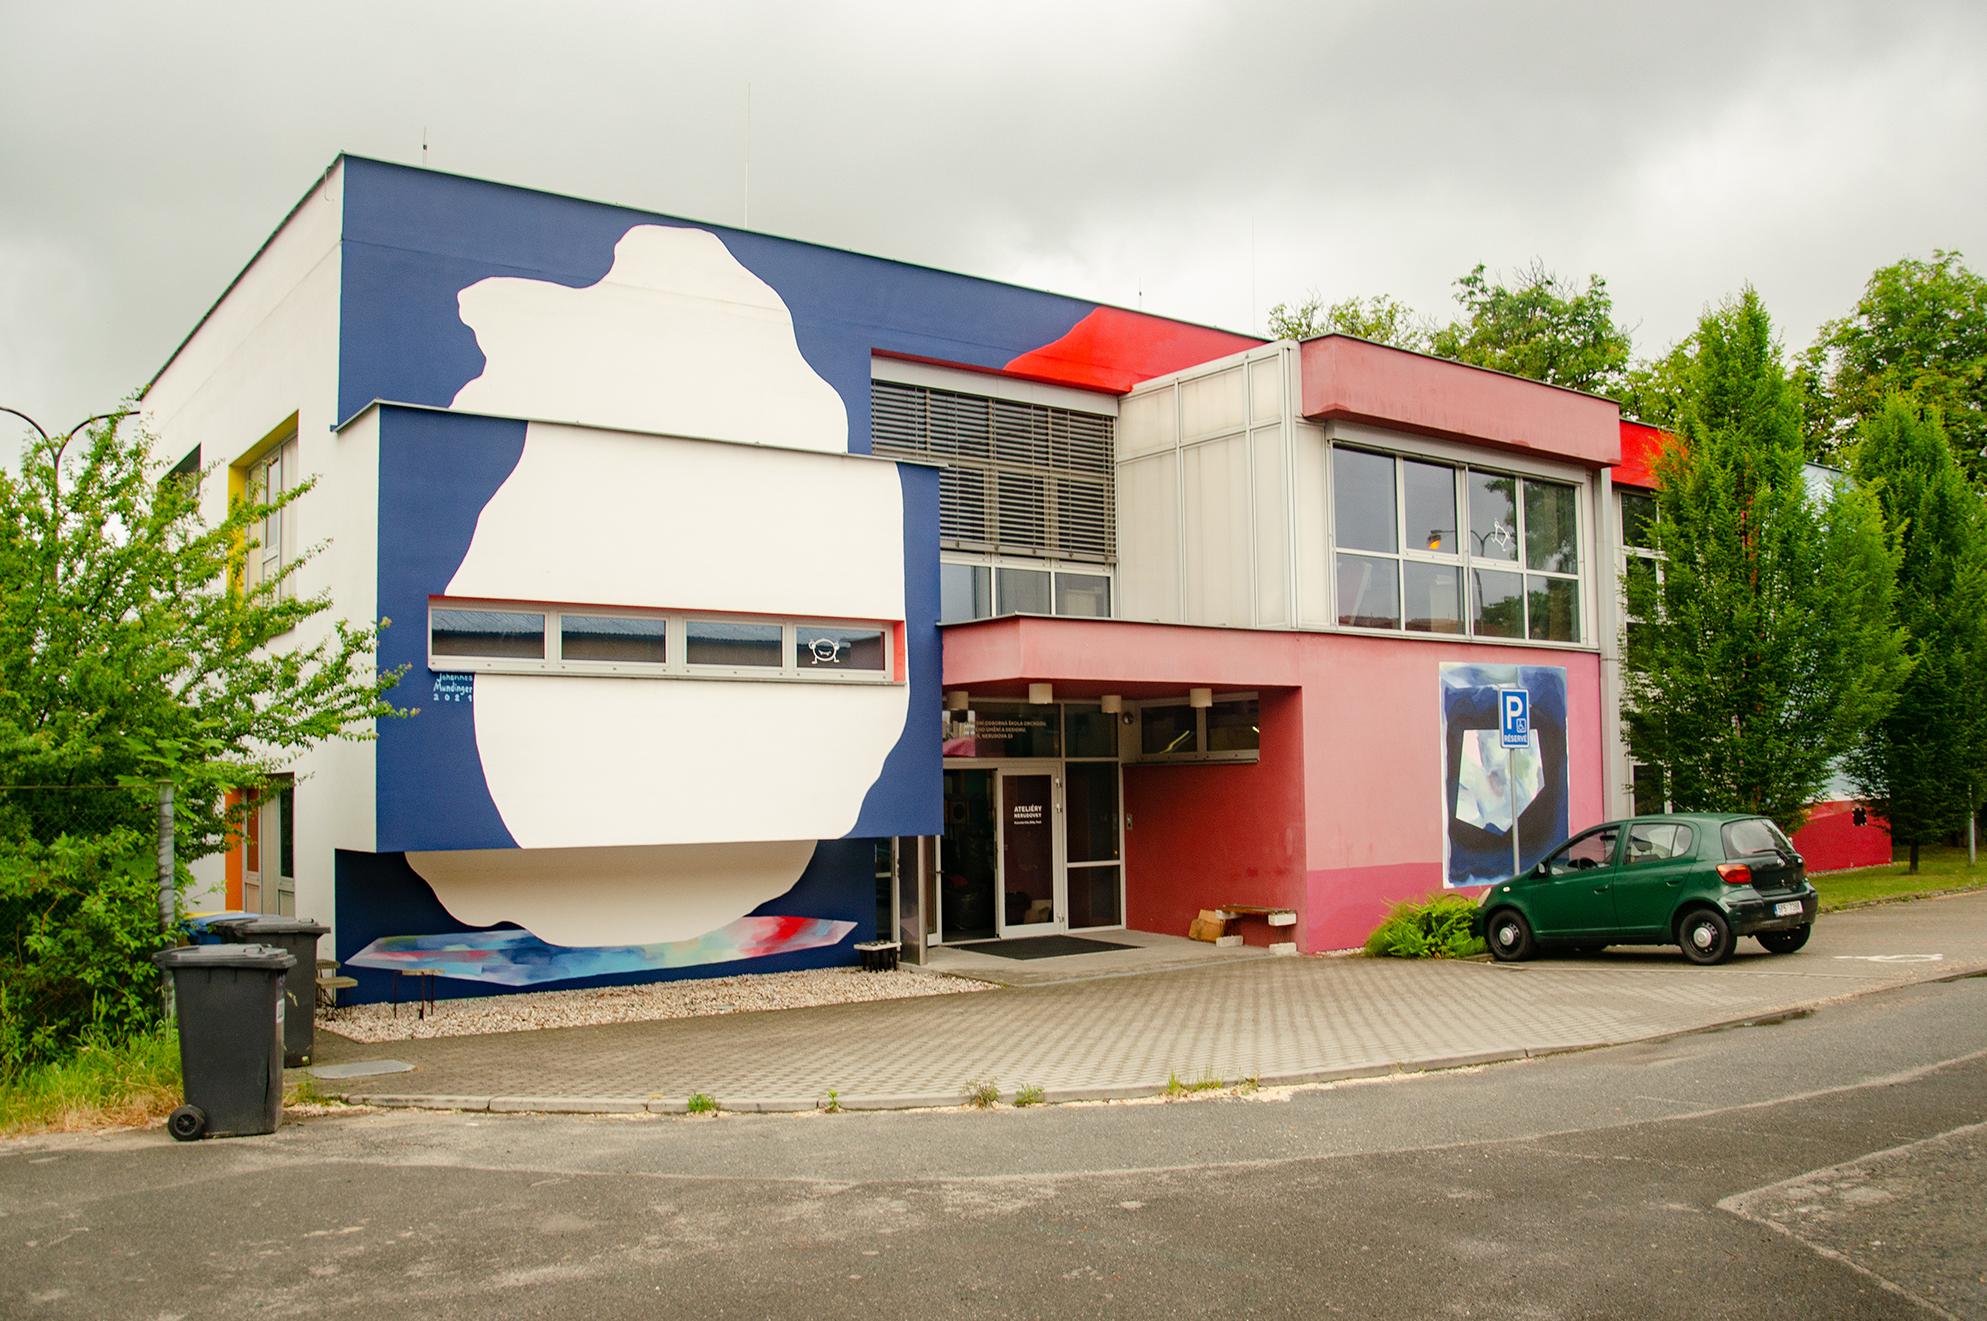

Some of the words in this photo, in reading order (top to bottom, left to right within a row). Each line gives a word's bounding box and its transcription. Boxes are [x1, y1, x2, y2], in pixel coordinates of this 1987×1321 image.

[436, 672, 473, 682] Johannes
[433, 680, 473, 695] Mundinger
[1506, 695, 1523, 729] P
[1014, 803, 1042, 812] ATELIÉRY
